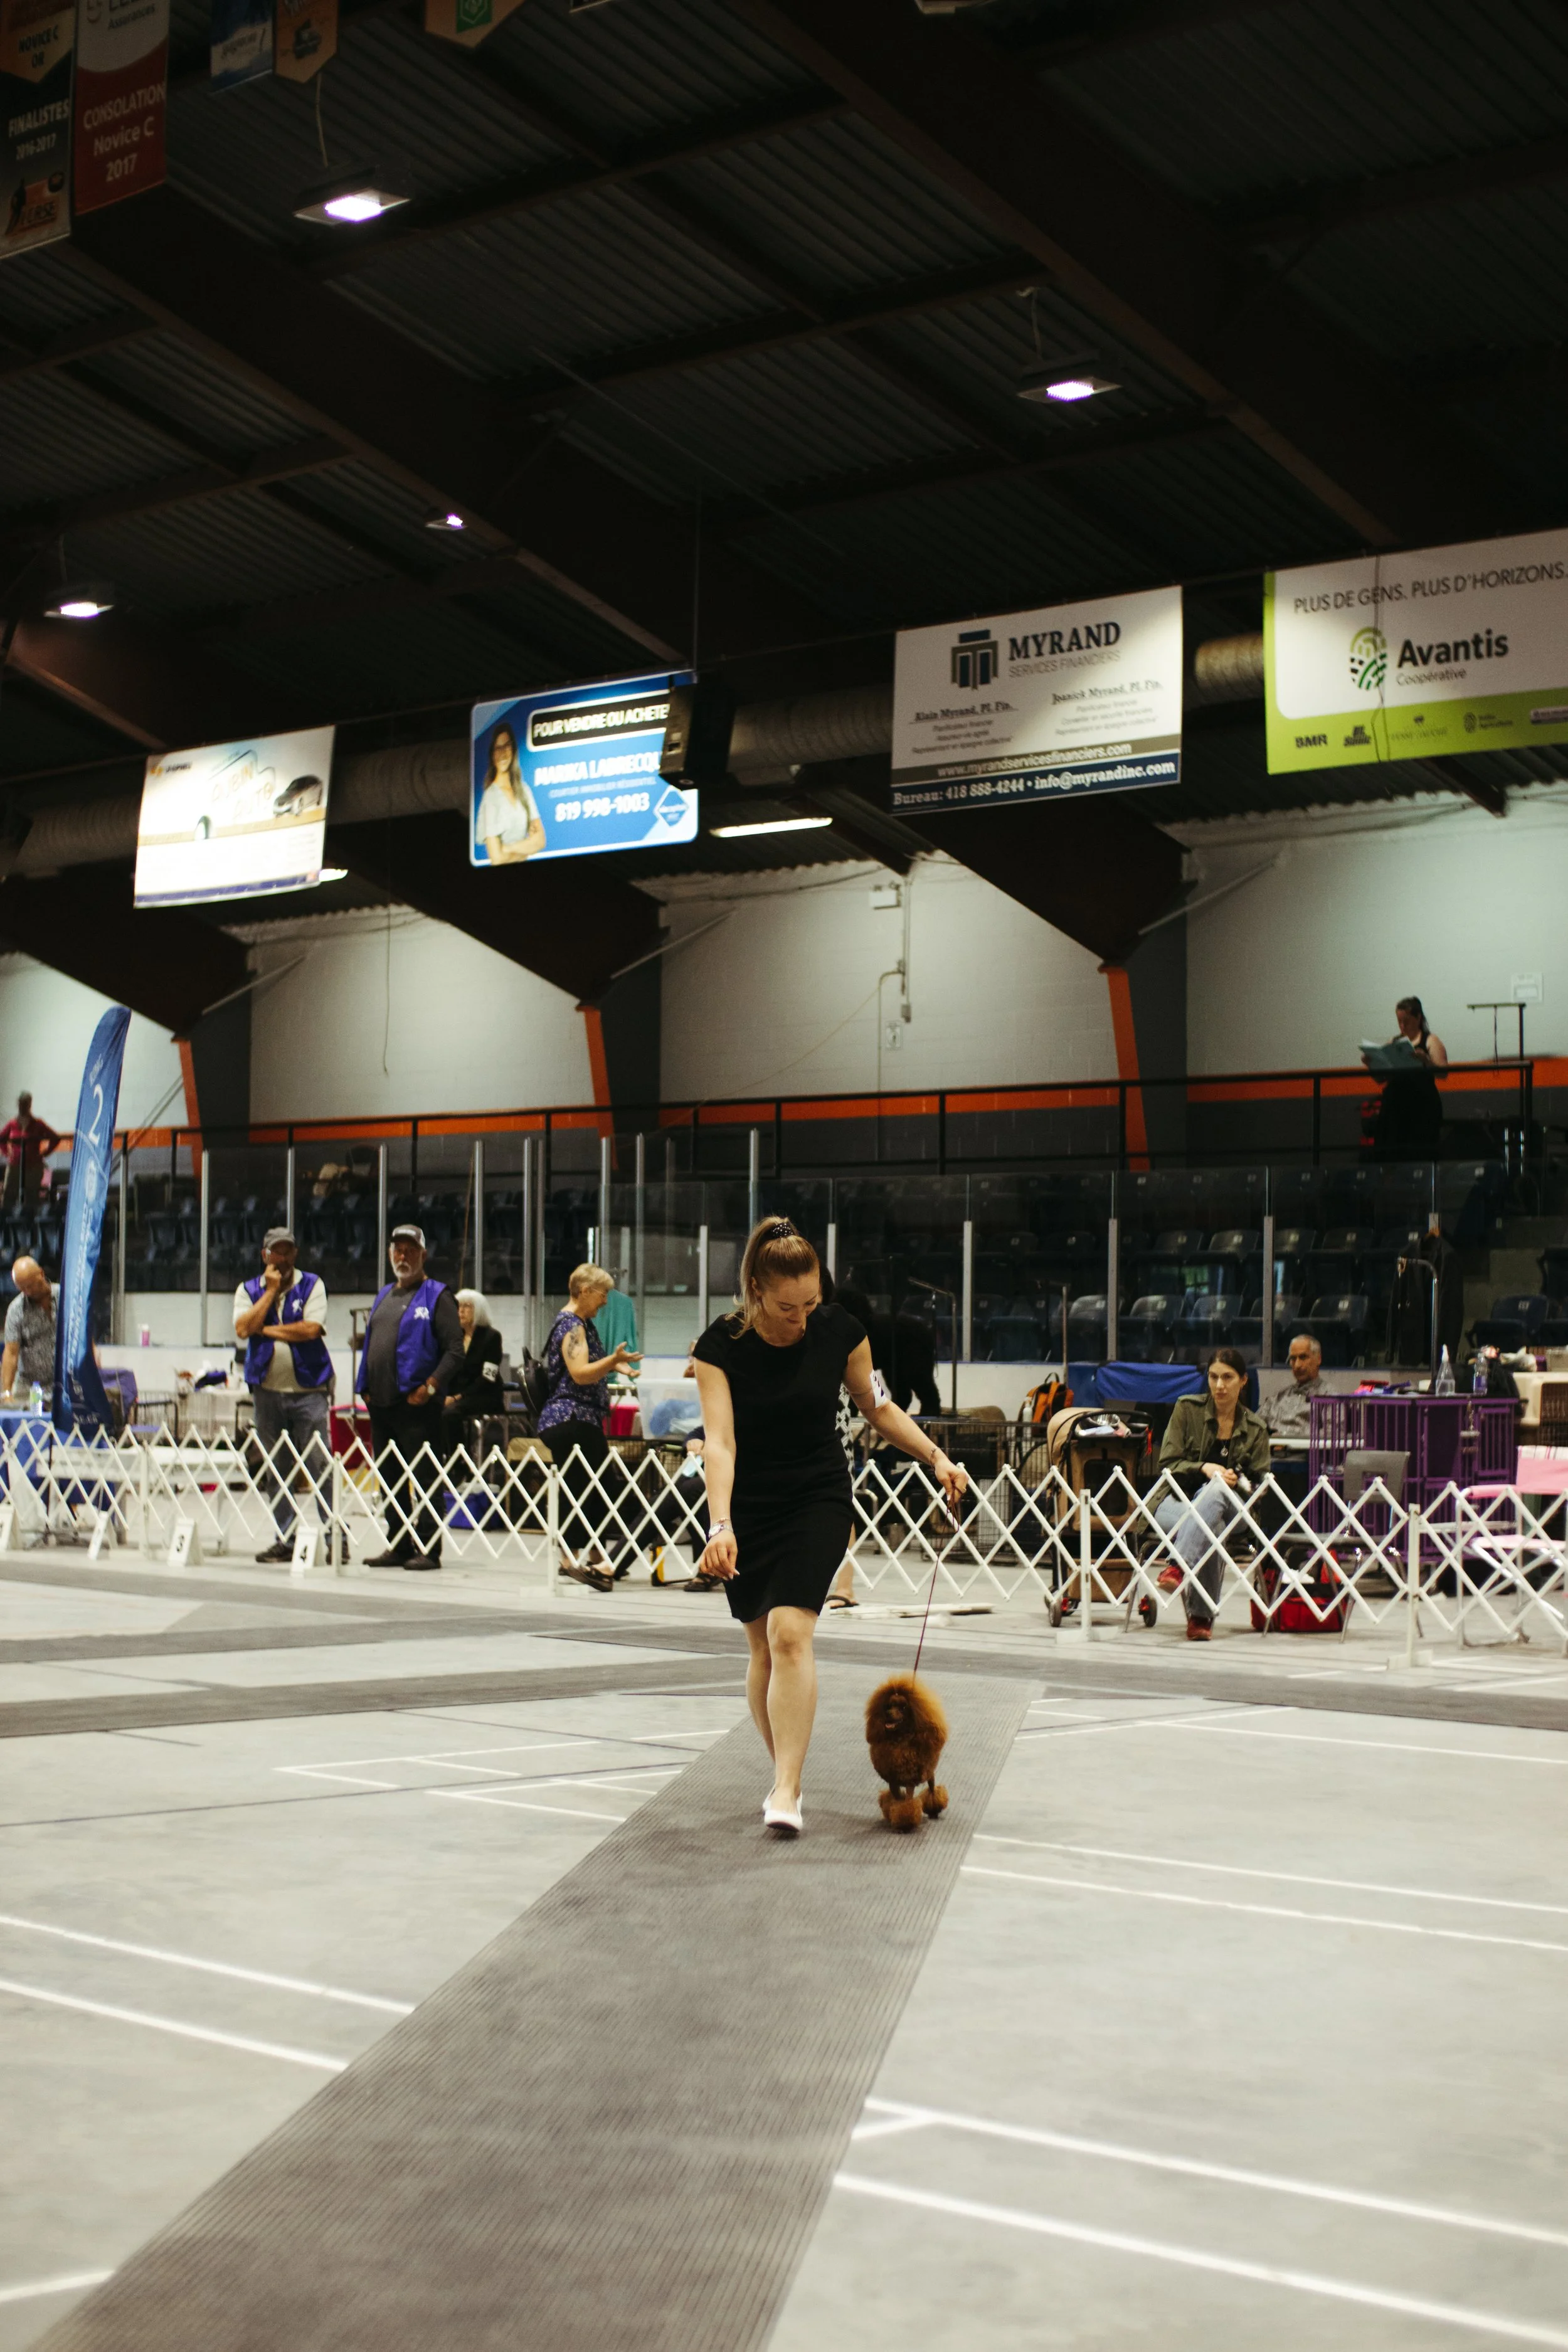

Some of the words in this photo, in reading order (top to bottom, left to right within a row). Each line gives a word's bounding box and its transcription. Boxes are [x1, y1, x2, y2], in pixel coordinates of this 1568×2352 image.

[19, 28, 50, 53] NOVICE
[53, 24, 59, 40] C
[9, 98, 70, 137] FINALISTES
[83, 82, 166, 130] CONSOLATION
[93, 125, 140, 156] Novice
[144, 116, 155, 137] C
[105, 152, 137, 183] 2017
[1293, 593, 1330, 615] PLUS
[1333, 590, 1355, 610] DE
[1411, 576, 1451, 598] PLUS
[1009, 622, 1121, 660] MYRAND
[1397, 628, 1508, 668] Avantis
[1009, 660, 1058, 678] SERVICES
[533, 719, 563, 738] POUR
[563, 713, 606, 733] VENDRE
[606, 711, 625, 728] OU
[893, 790, 943, 806] Bureau:
[945, 785, 967, 800] 418
[970, 778, 1025, 797] 888-4244
[1034, 761, 1176, 790] info@myrandinc.com
[89, 1084, 103, 1146] 2
[176, 1535, 184, 1552] 3
[300, 1545, 308, 1562] 4
